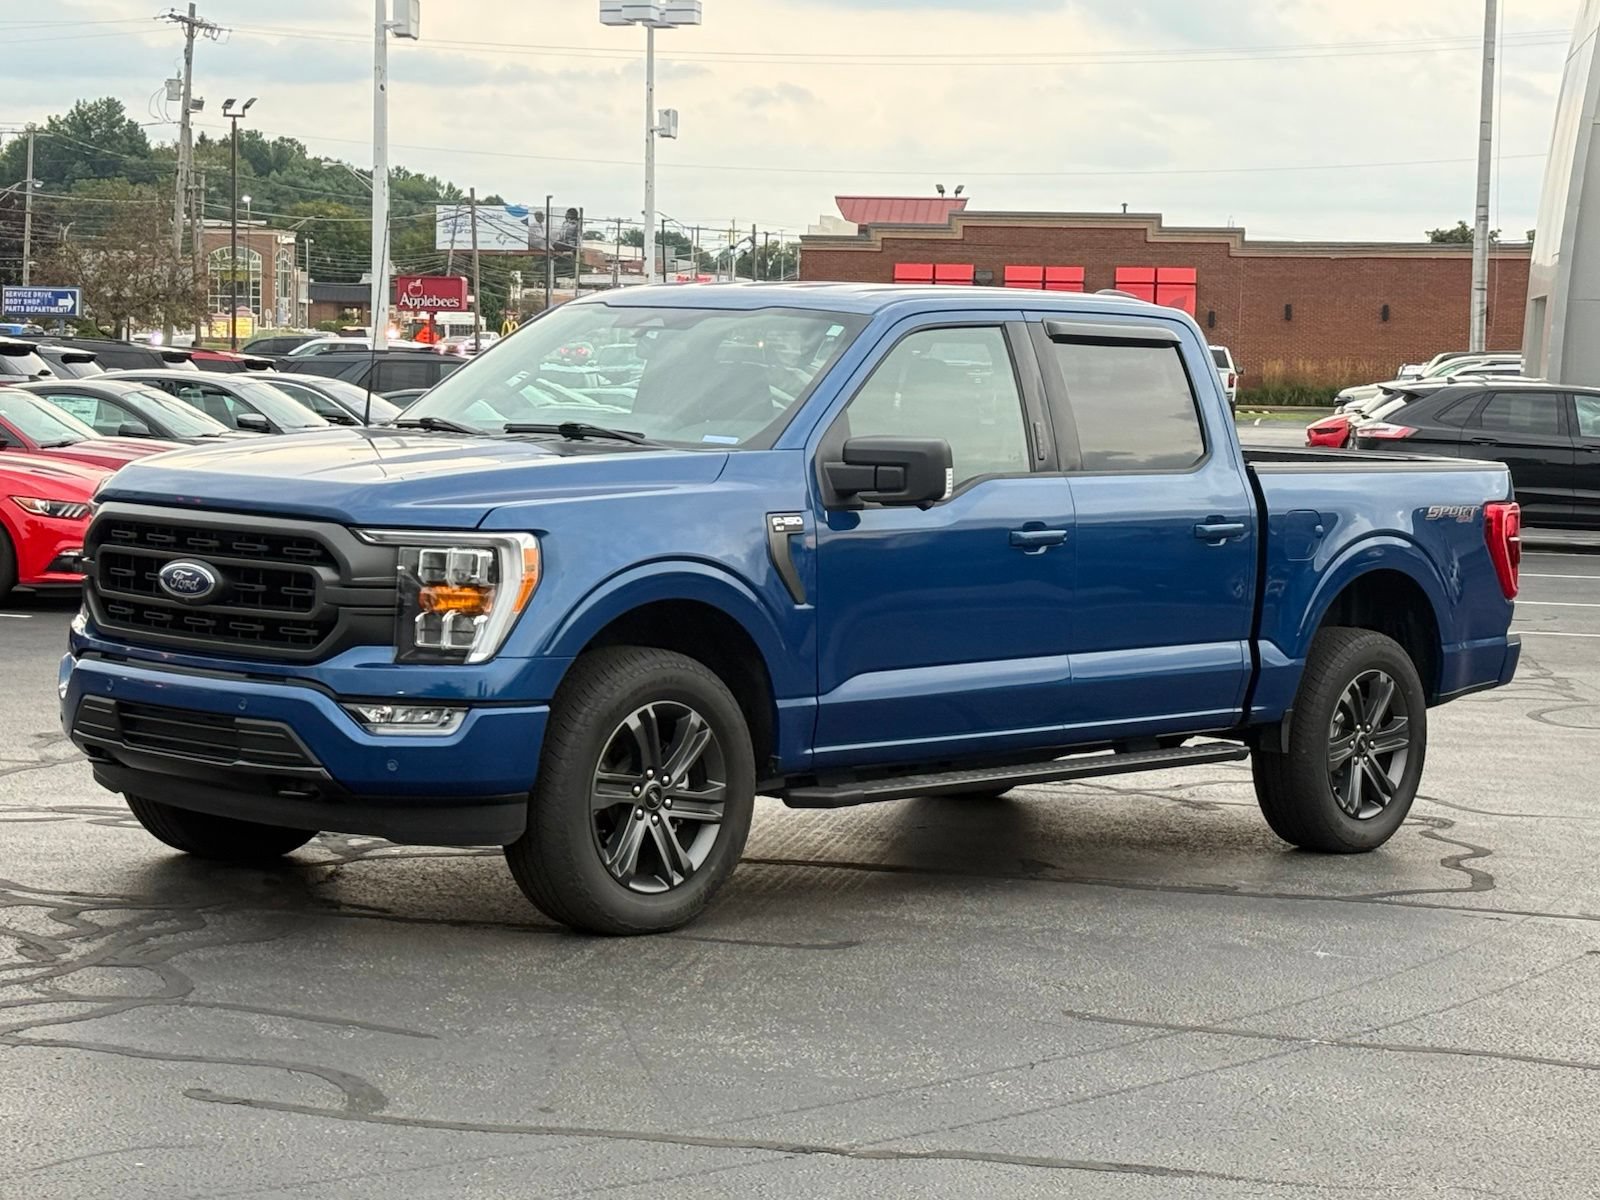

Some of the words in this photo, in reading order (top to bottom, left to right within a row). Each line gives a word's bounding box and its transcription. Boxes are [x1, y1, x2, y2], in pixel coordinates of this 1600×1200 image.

[26, 305, 67, 313] DEPARTMENT
[1425, 505, 1479, 520] SPORT
[170, 570, 200, 591] Ford
